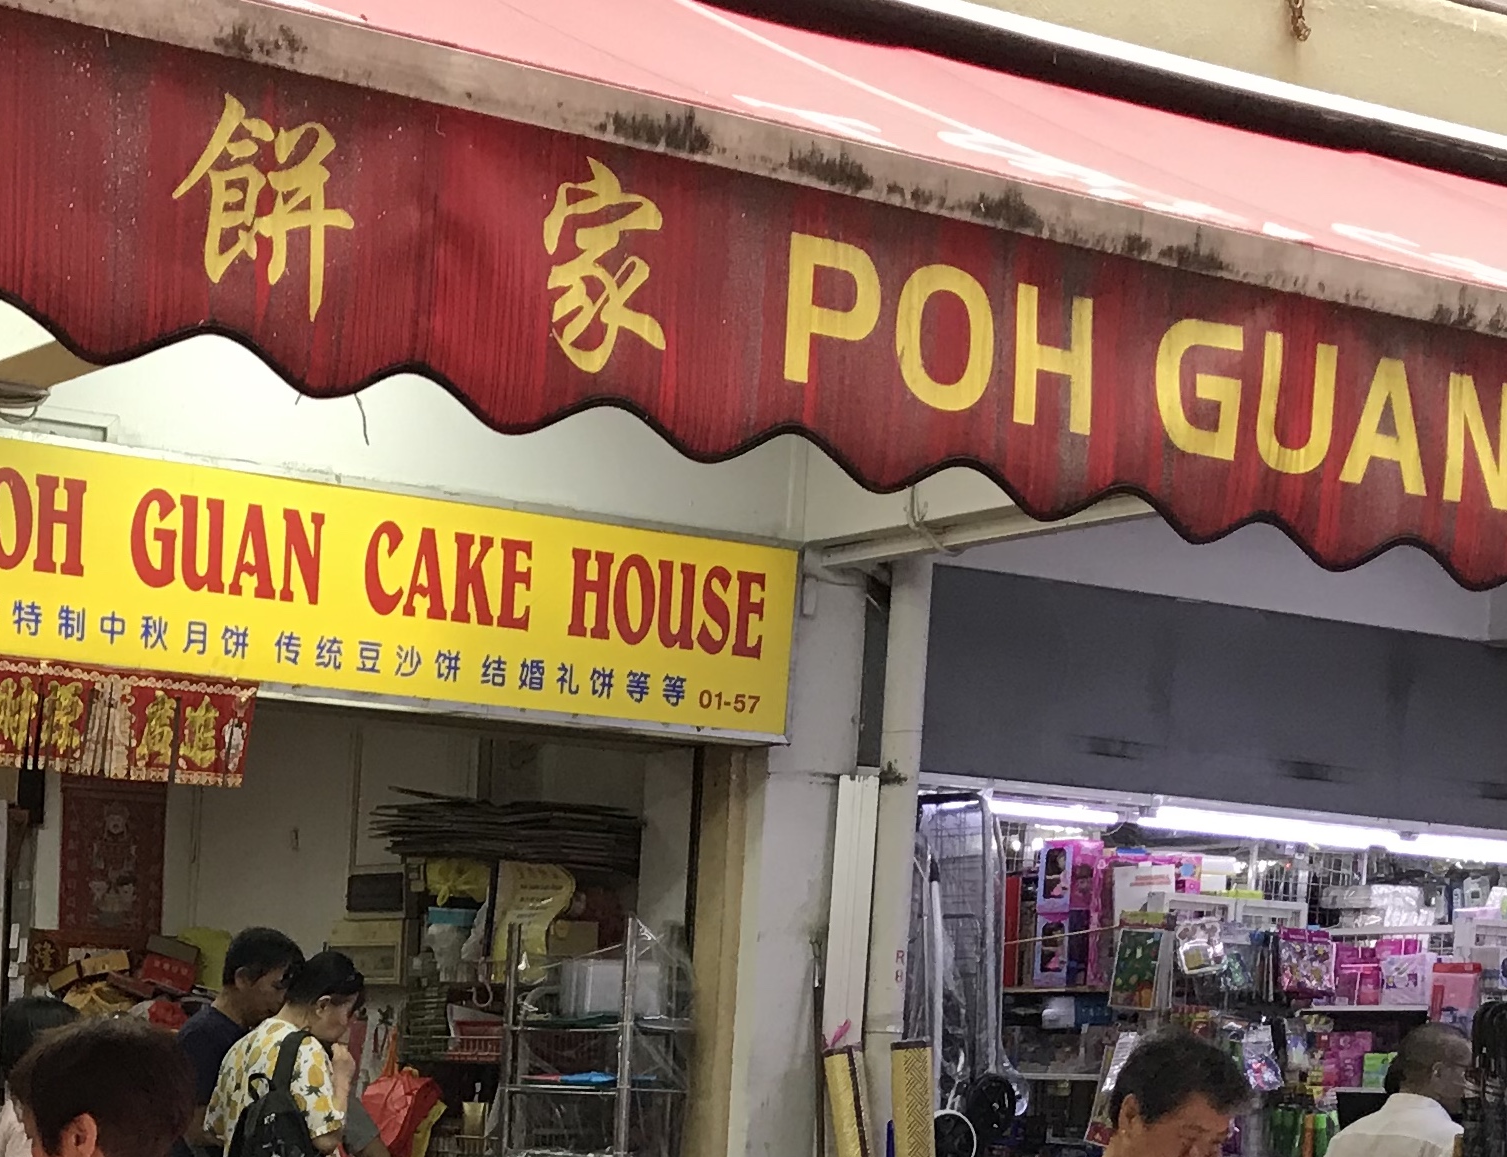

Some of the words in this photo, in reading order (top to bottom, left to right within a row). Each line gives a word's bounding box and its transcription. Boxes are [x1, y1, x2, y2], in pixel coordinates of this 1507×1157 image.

[783, 231, 1094, 436] POH
[1155, 318, 1507, 512] GUAN
[130, 487, 324, 606] GUAN
[364, 520, 533, 631] CAKE
[568, 547, 766, 660] HOUSE
[275, 632, 462, 684] 传统豆沙饼
[480, 652, 687, 705] 结婚礼饼等等
[698, 689, 761, 714] 01-57
